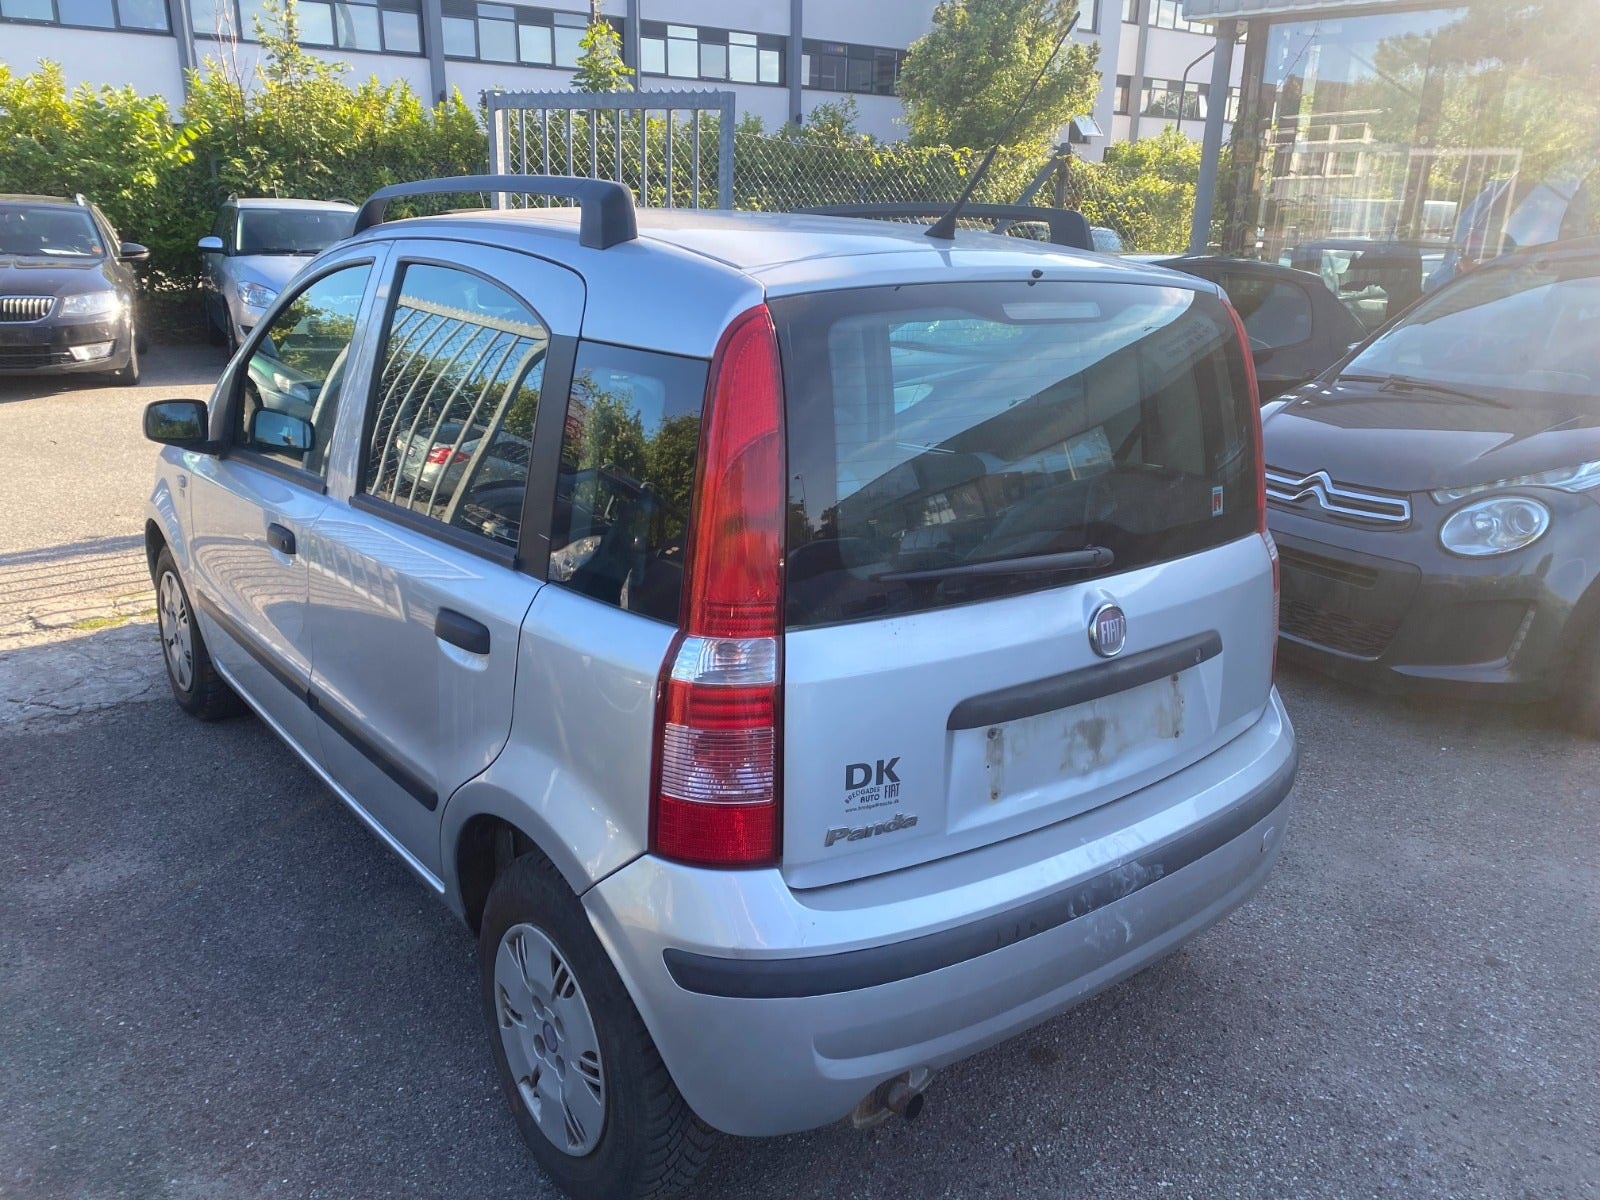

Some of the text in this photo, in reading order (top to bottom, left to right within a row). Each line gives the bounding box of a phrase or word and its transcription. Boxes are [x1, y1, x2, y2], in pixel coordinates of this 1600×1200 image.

[1100, 618, 1120, 644] FIAT
[845, 757, 901, 791] DK
[860, 793, 880, 803] AUTO
[884, 783, 900, 799] FIAT
[824, 813, 918, 848] Panda
